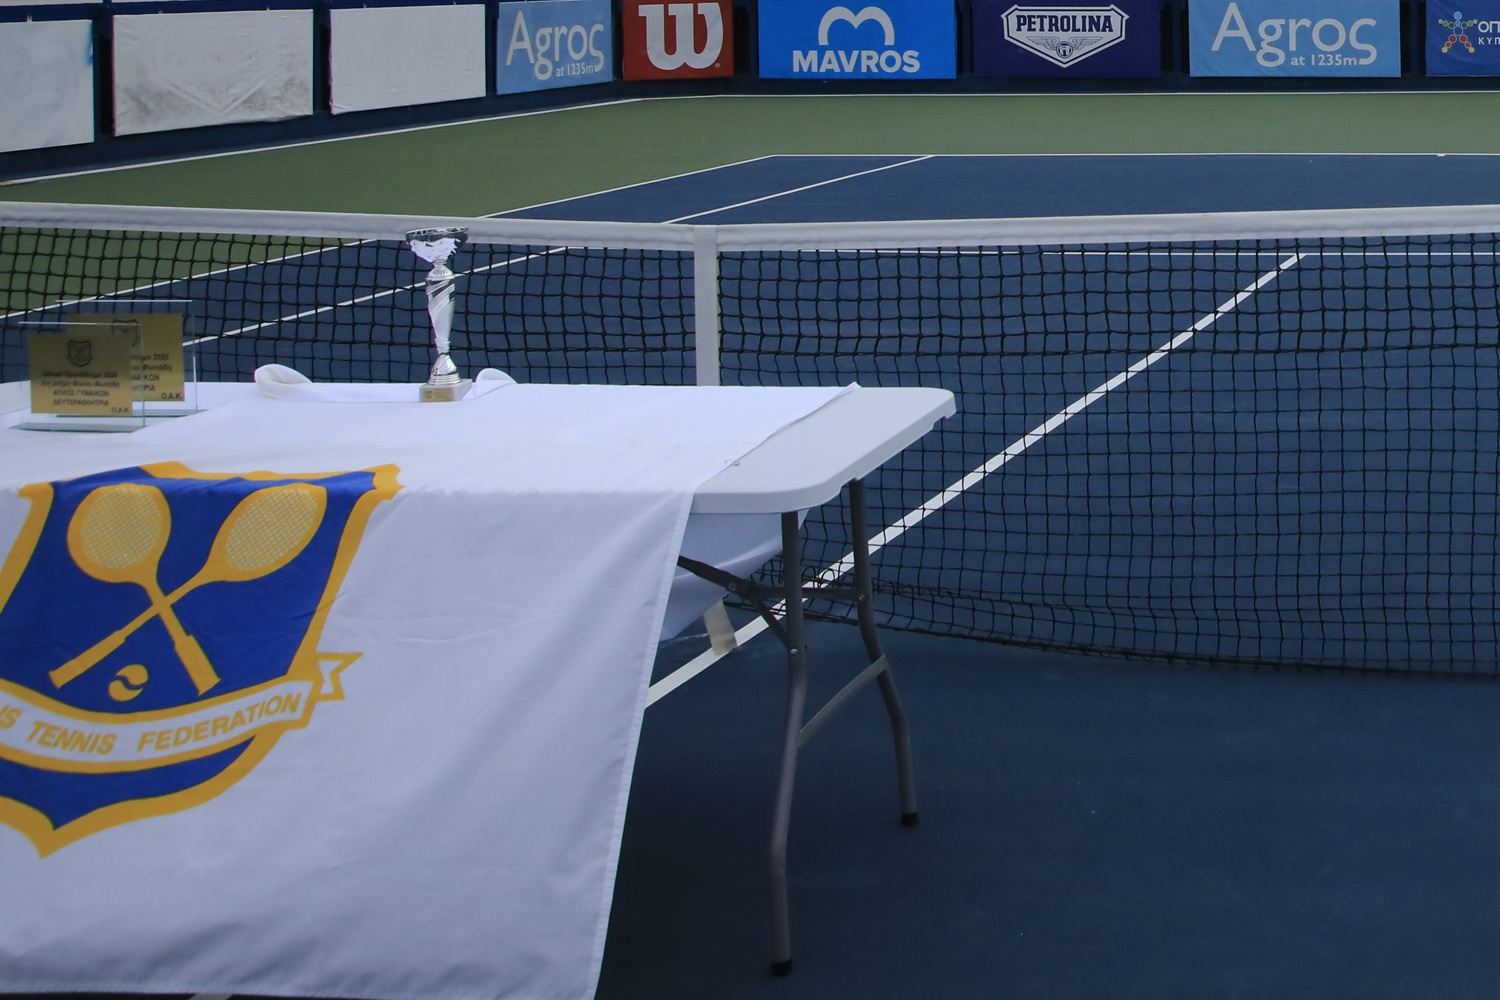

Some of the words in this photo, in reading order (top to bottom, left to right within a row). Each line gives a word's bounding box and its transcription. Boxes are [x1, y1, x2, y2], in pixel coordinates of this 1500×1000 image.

[1016, 15, 1113, 32] PETROLINA
[793, 50, 920, 73] MAVROS
[1290, 55, 1305, 66] at
[1311, 54, 1357, 66] 1235m
[555, 66, 565, 78] at
[26, 720, 118, 756] TENNIS
[136, 692, 303, 753] FEDERATION
